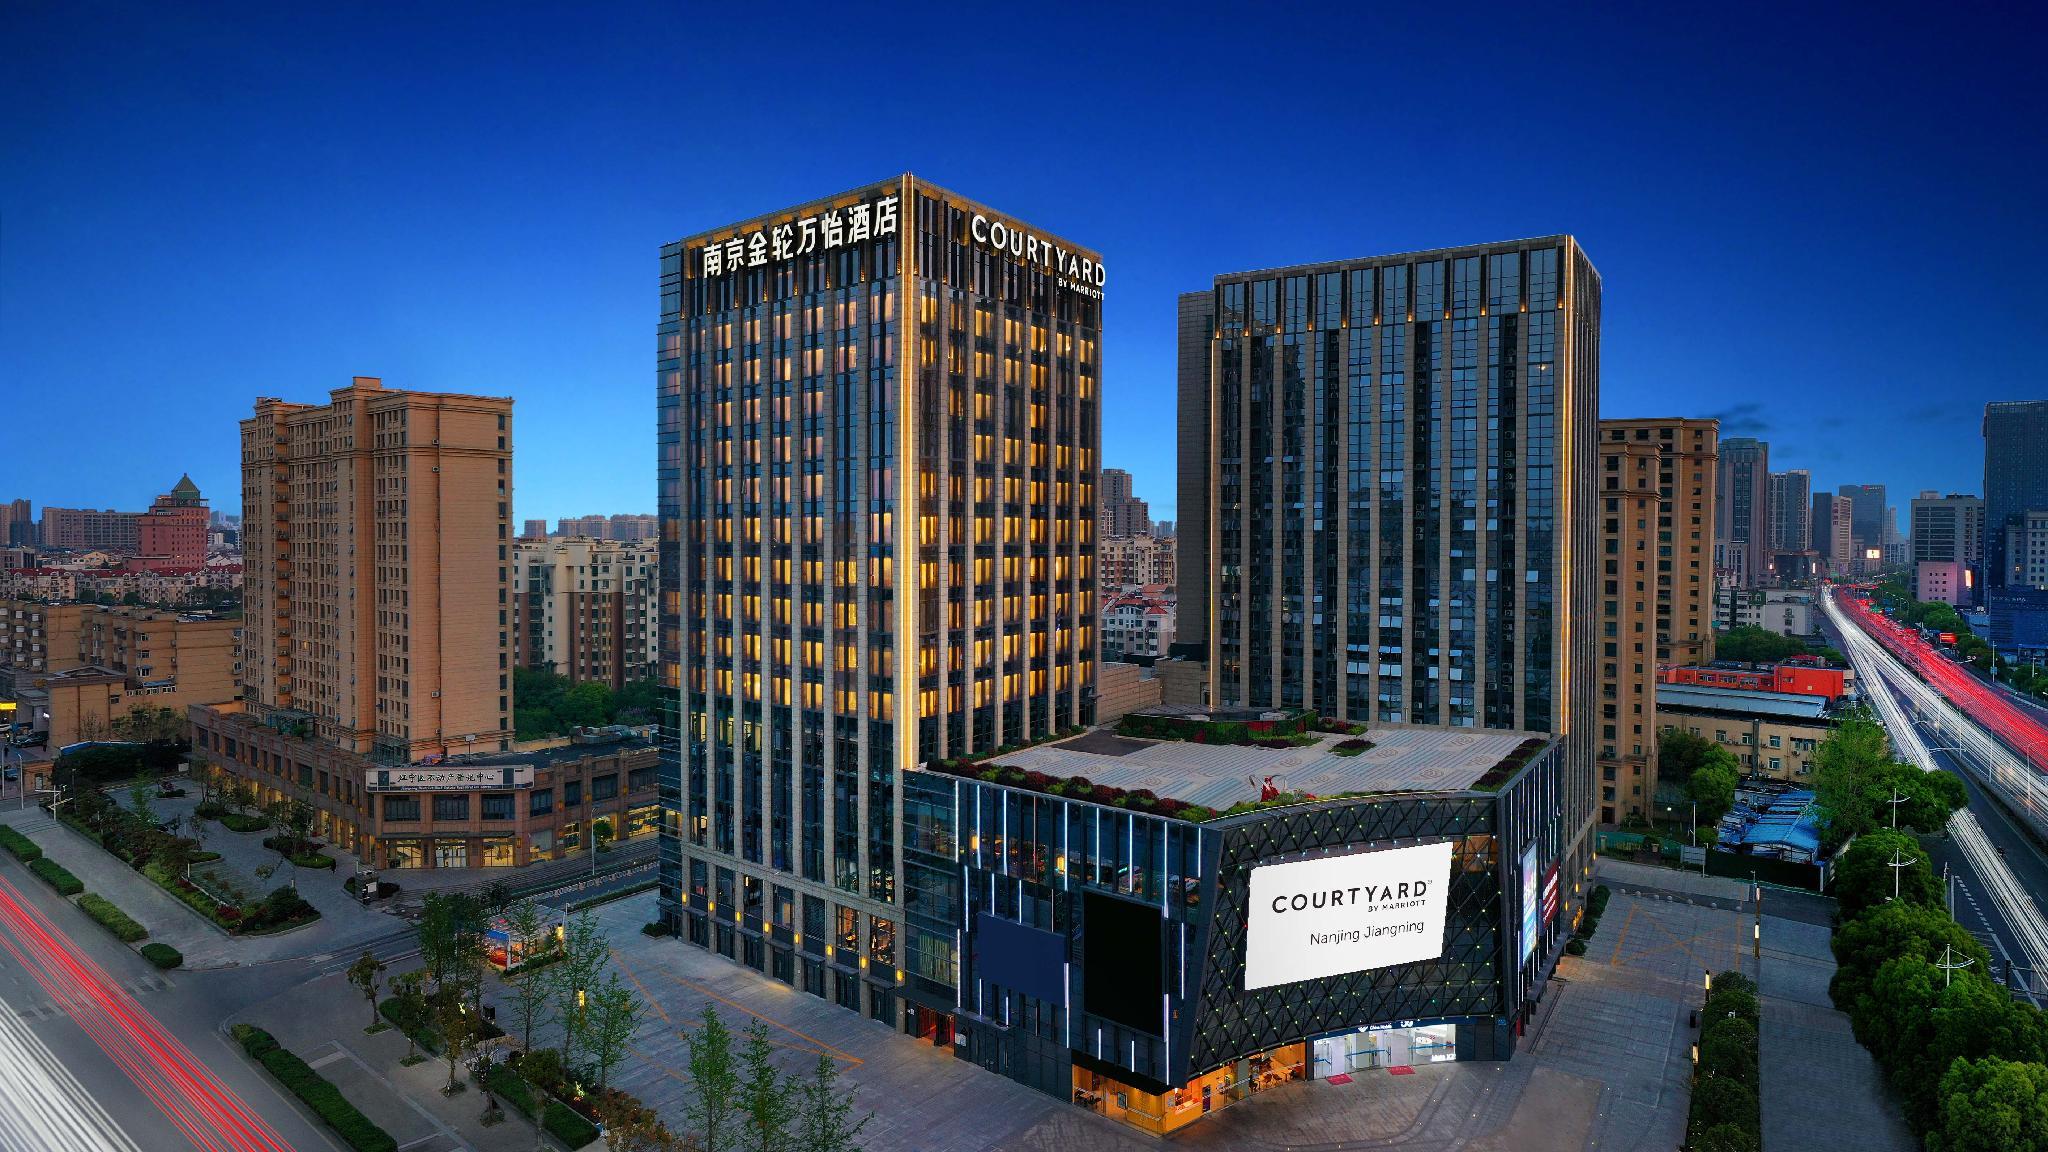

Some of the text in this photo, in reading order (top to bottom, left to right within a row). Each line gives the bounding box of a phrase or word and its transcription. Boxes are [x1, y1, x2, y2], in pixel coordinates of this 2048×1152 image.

[703, 196, 899, 279] 南京金轮万怡酒店
[971, 214, 1106, 287] COURTYARD
[1058, 277, 1105, 301] BY MARRIOTT
[1271, 880, 1427, 914] COURTYARD
[1367, 899, 1426, 913] BY MARRIOTT
[1310, 920, 1424, 946] Nanjing Jiangning
